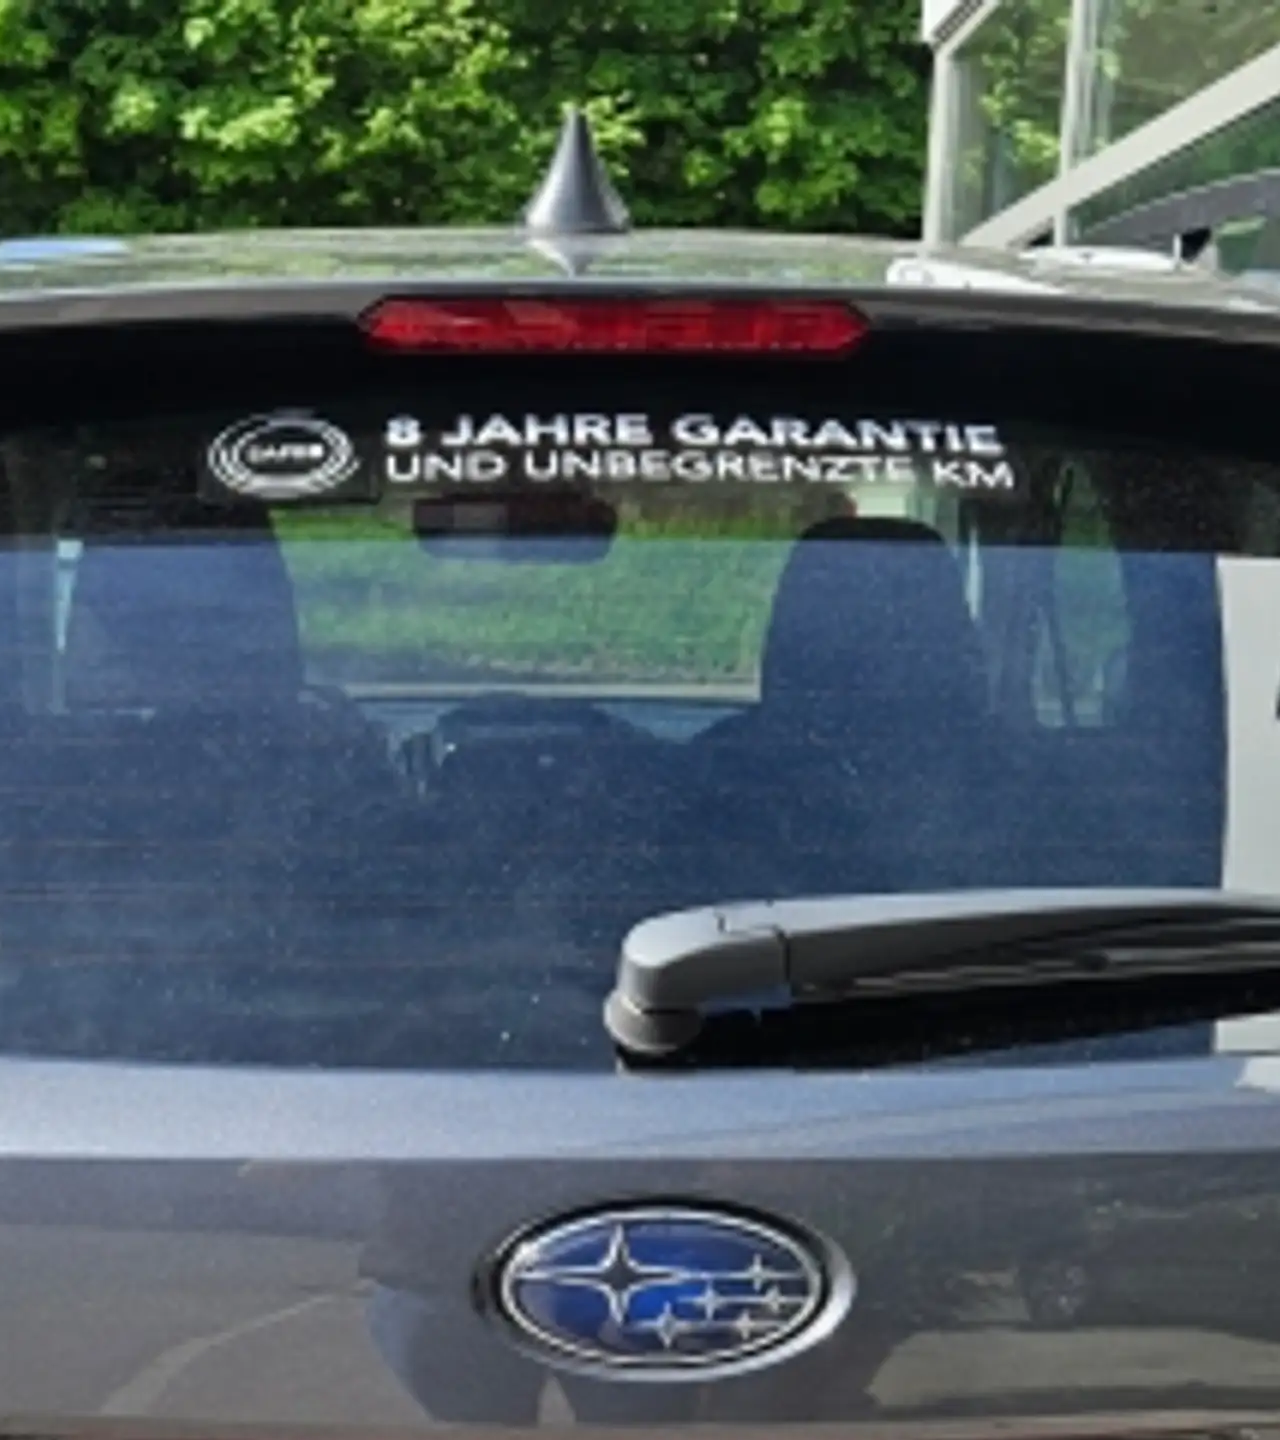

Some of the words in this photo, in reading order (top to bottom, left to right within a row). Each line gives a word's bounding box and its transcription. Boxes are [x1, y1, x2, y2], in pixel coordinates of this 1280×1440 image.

[386, 416, 420, 447] 8
[440, 413, 653, 447] JAHRE
[672, 413, 1006, 457] GARANTIE
[386, 450, 510, 483] UND
[523, 449, 917, 484] UNBEGRENZTE
[932, 458, 1015, 490] KM
